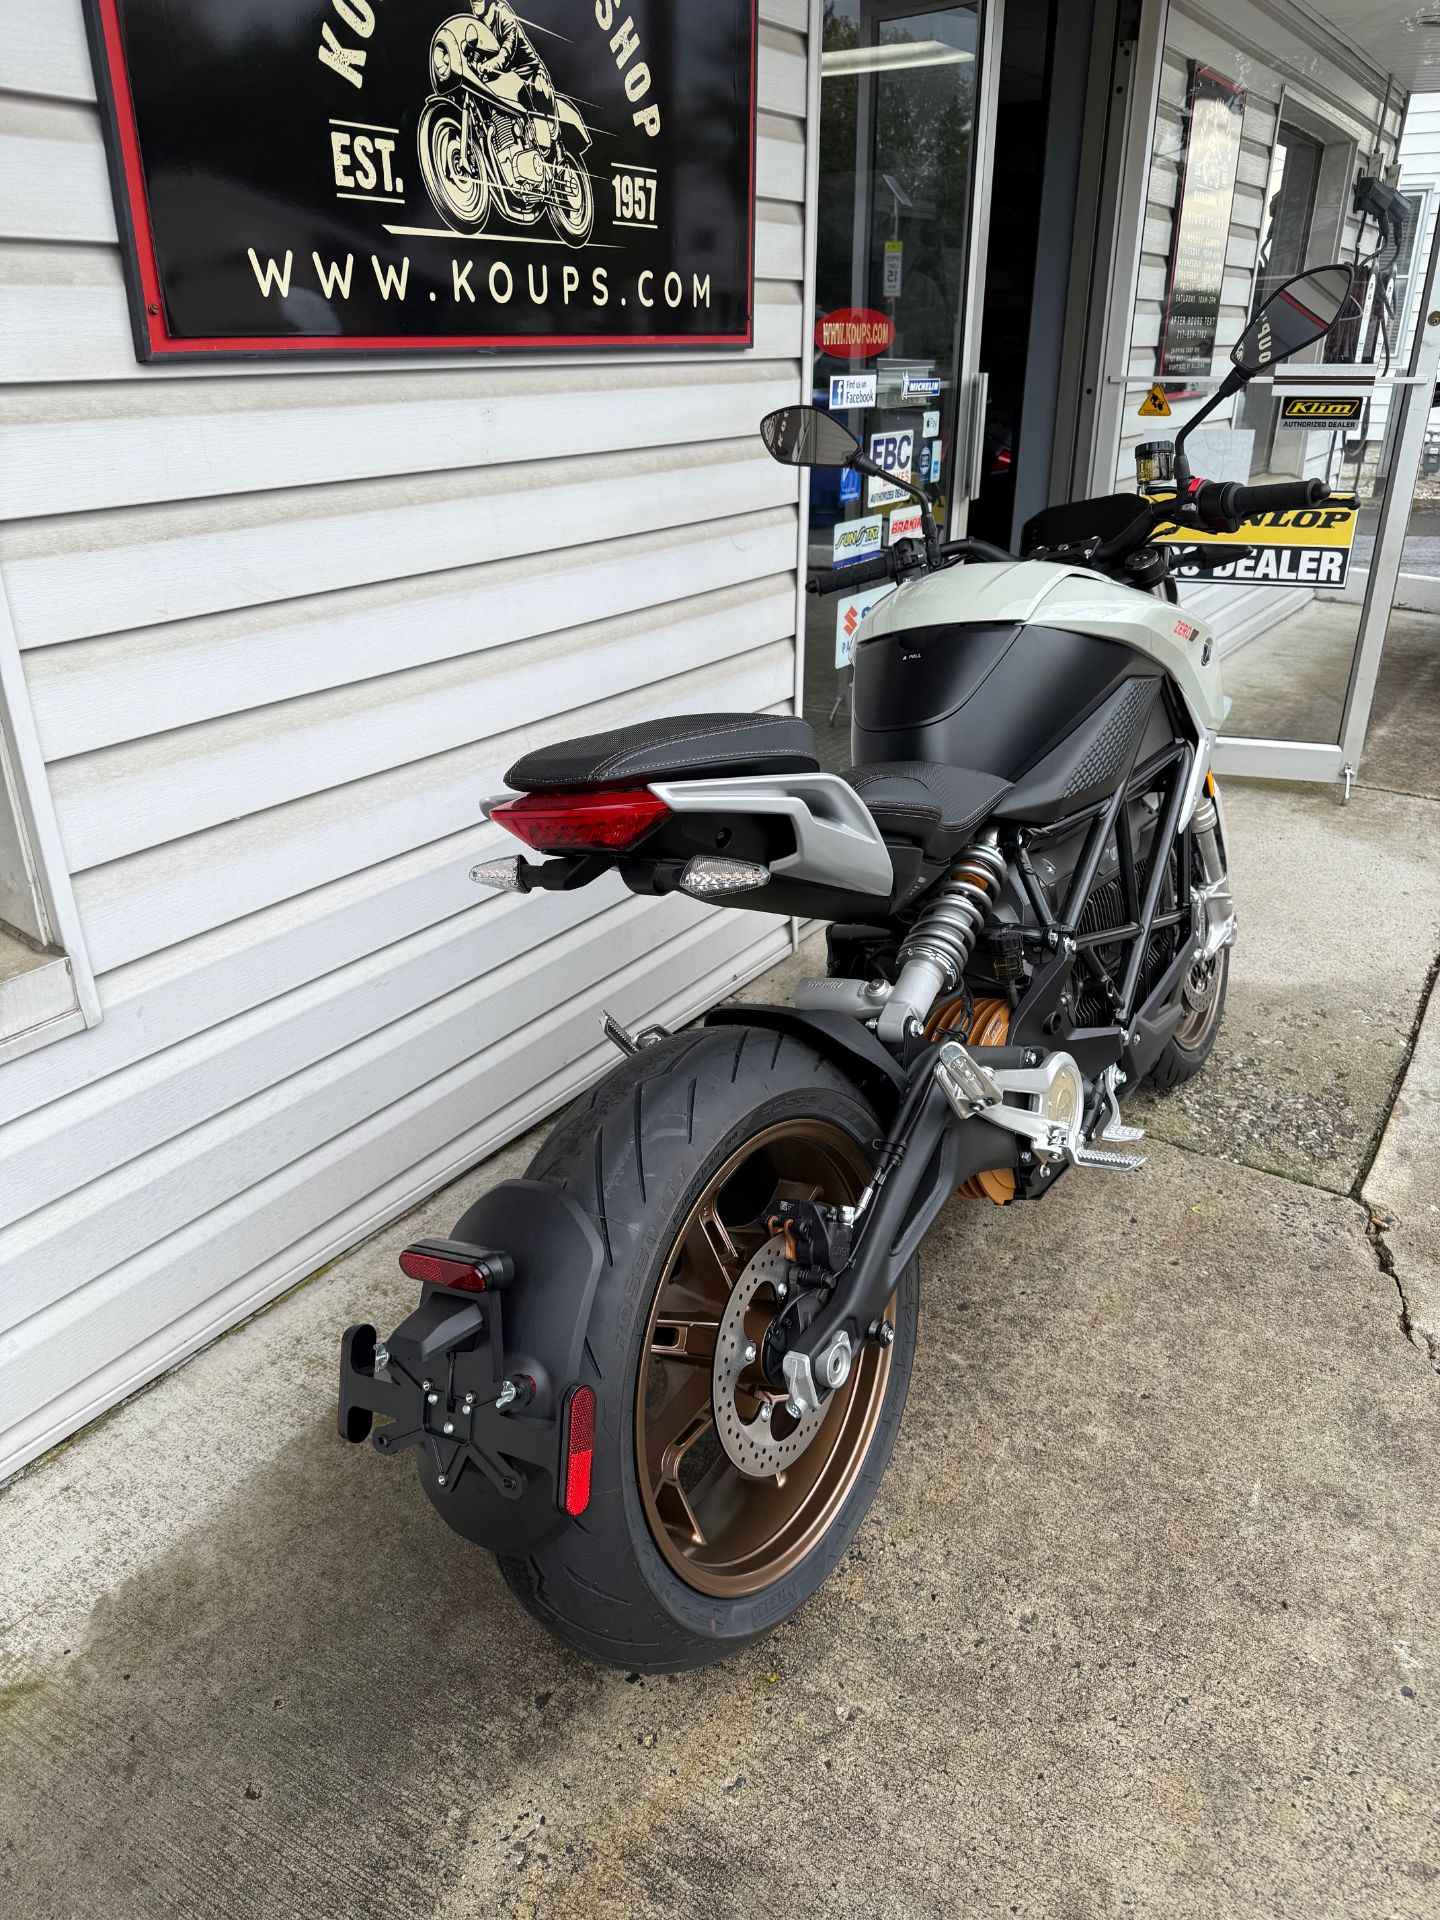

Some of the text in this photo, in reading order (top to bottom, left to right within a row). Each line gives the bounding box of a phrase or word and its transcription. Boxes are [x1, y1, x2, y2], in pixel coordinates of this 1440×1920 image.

[331, 131, 404, 193] EST.
[611, 174, 657, 221] 1957
[247, 247, 711, 309] WWW.KOUPS.COM
[1170, 315, 1216, 326] AFTER HOURS TEXT
[822, 322, 889, 346] WWW.KOUPS.COM
[846, 379, 856, 389] Find
[909, 381, 939, 392] MICHELIN
[846, 389, 874, 404] Facebook
[1290, 402, 1352, 415] Klim
[1283, 421, 1356, 429] AUTHORIZED DEALER
[872, 435, 912, 470] EBC
[892, 516, 923, 535] BRAKIN
[1172, 620, 1193, 640] ZERO
